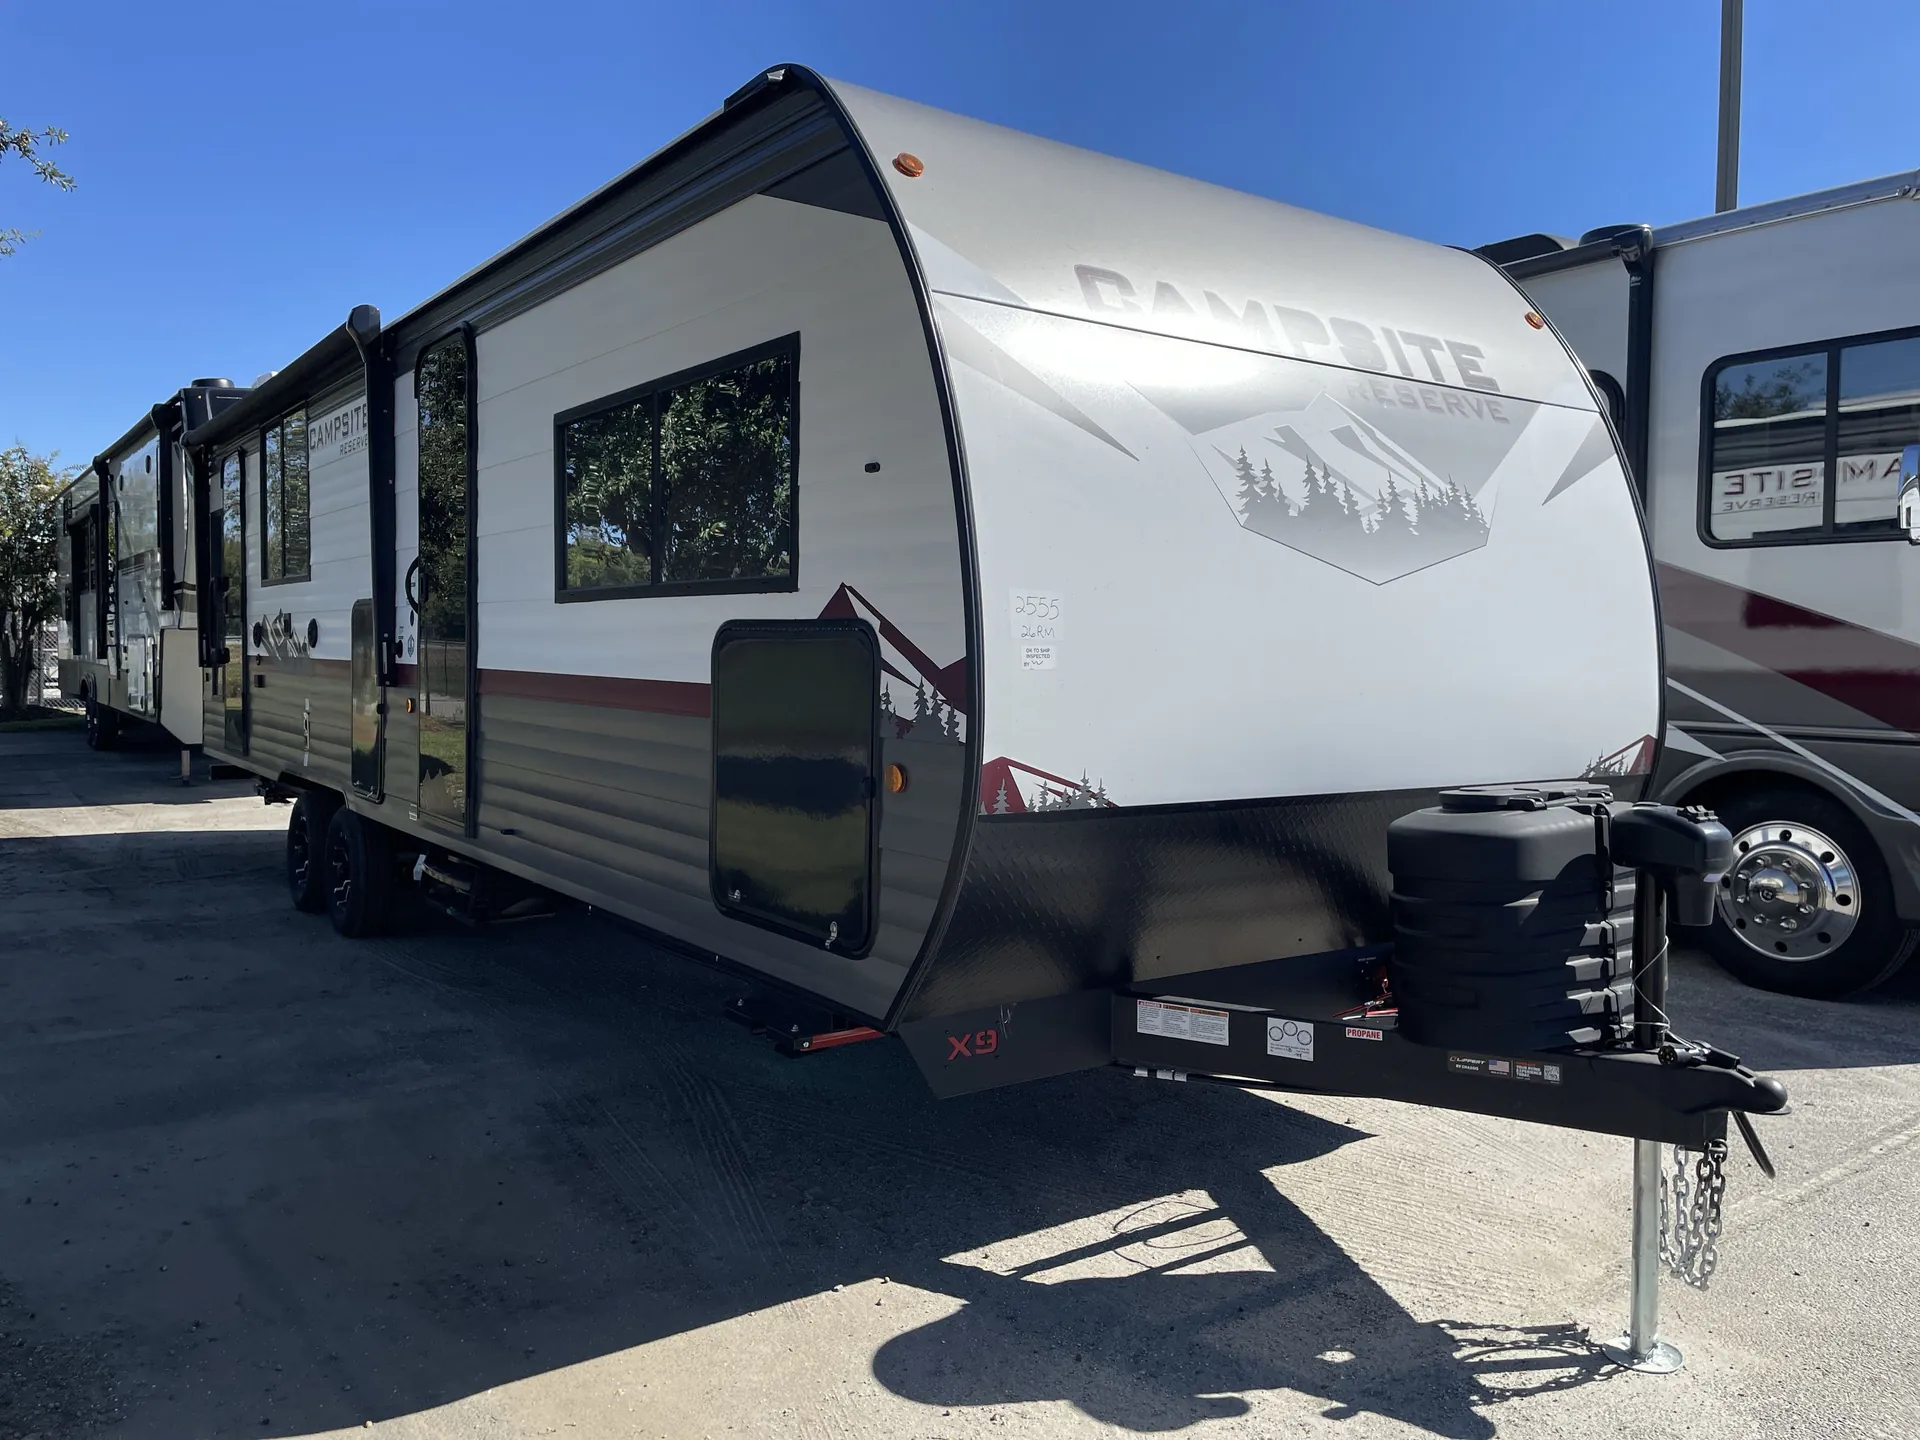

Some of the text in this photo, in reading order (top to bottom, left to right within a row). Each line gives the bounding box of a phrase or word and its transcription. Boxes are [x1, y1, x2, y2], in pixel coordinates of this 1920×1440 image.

[1074, 264, 1500, 393] CAMPSITE
[1347, 377, 1511, 424] RESERVE
[309, 403, 367, 451] CAMPSITE
[340, 433, 368, 456] RESERVE
[1016, 595, 1060, 621] 2555
[1021, 624, 1055, 639] 26RM
[947, 1029, 998, 1061] X9
[1347, 1029, 1380, 1039] PROPANE
[1456, 1057, 1485, 1065] LIPPERT
